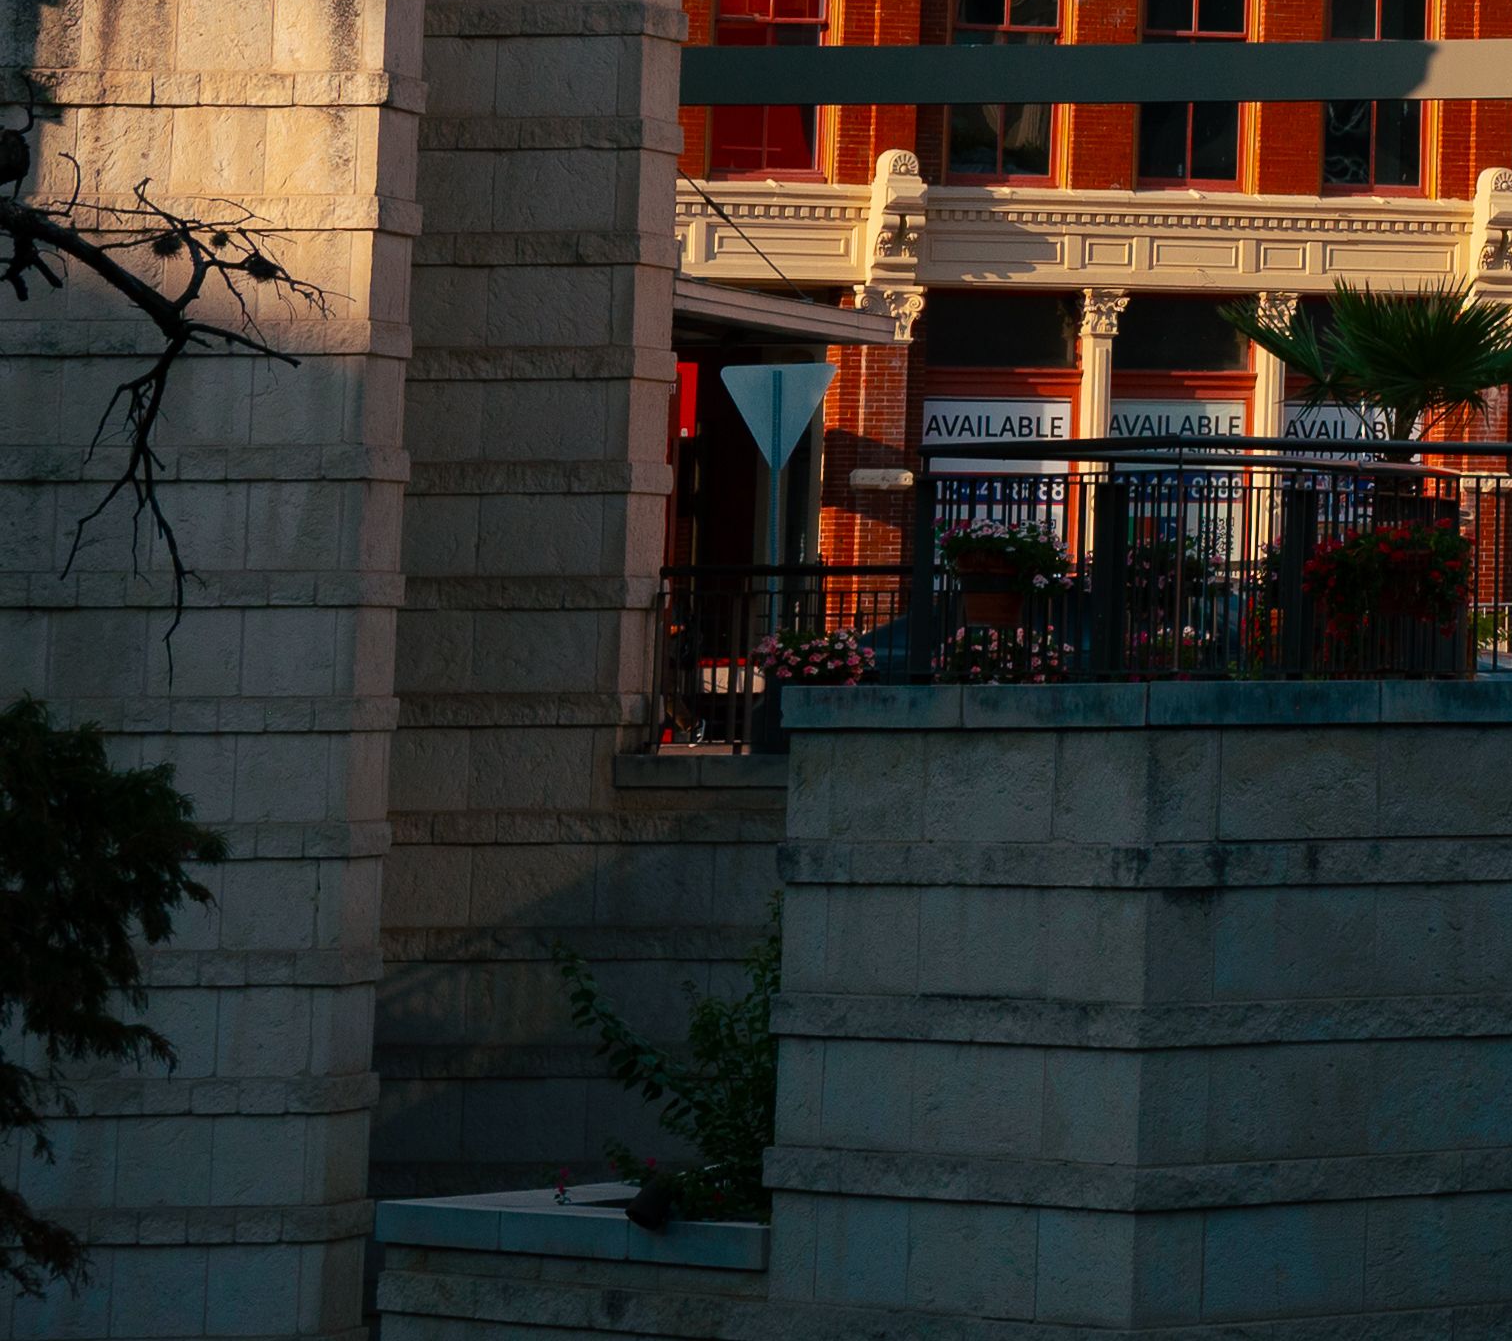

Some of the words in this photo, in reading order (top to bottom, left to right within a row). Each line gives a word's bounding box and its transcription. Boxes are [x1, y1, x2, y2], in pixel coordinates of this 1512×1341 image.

[925, 415, 1064, 438] AVAILABLE
[1109, 414, 1242, 437] AVAILABLE
[1284, 419, 1387, 440] AVAILAB
